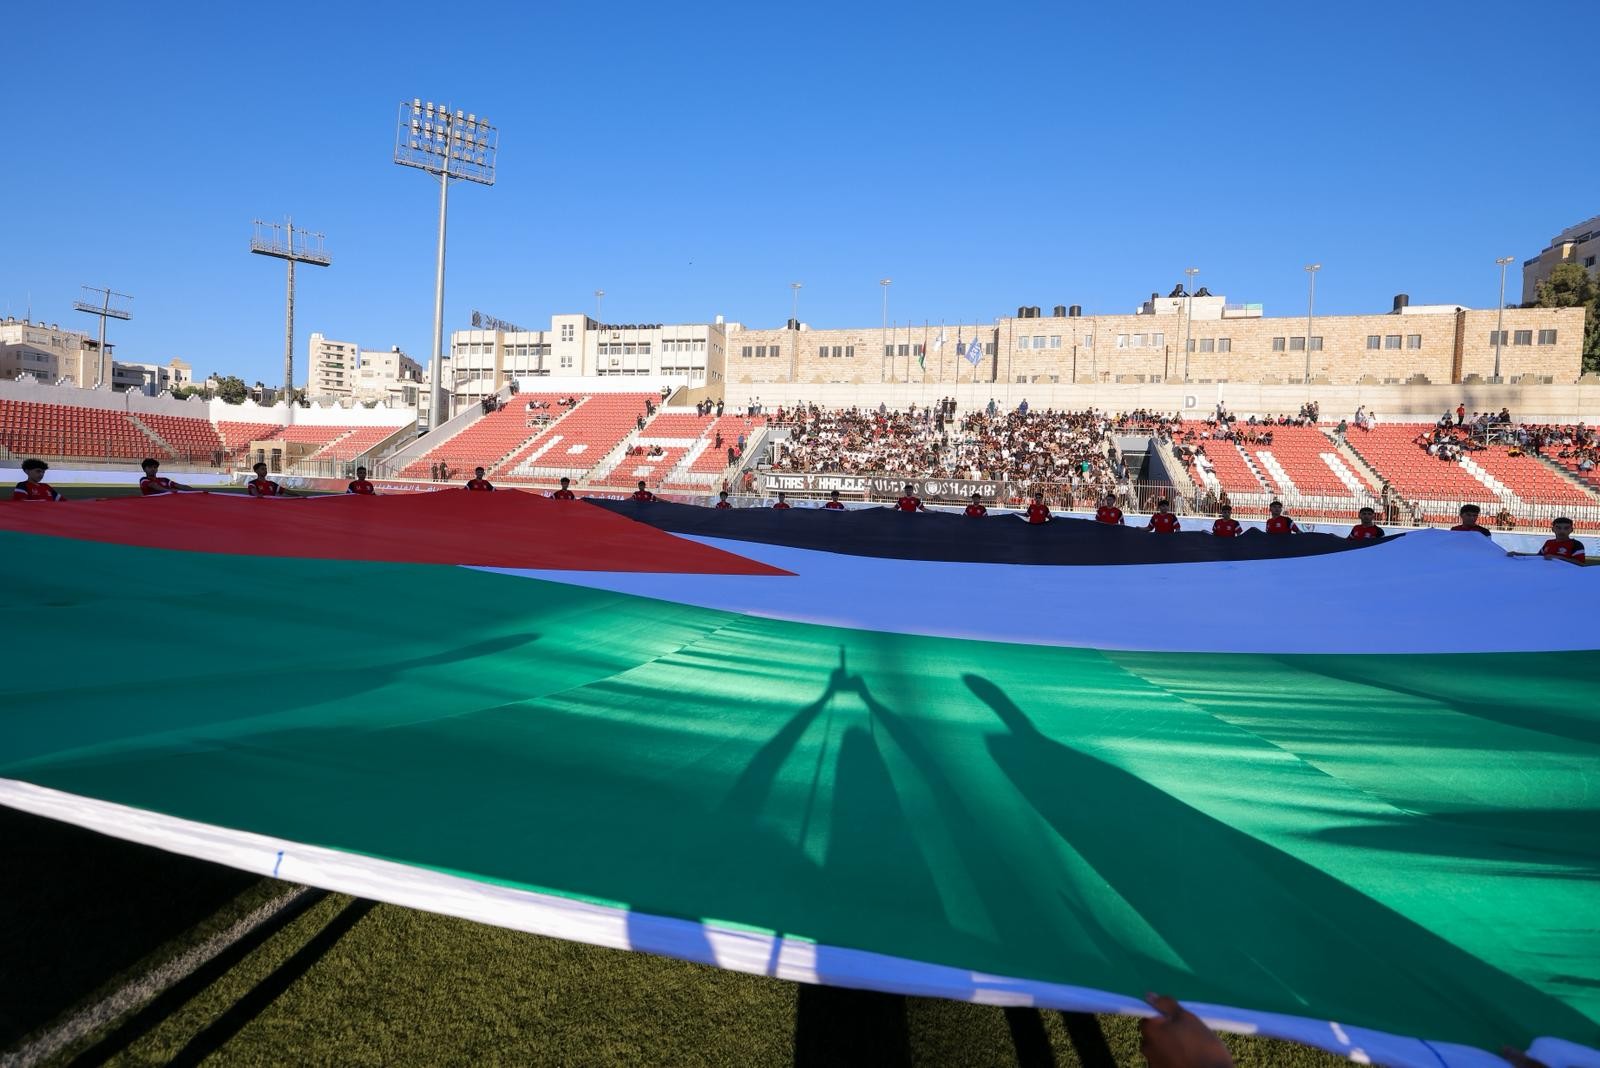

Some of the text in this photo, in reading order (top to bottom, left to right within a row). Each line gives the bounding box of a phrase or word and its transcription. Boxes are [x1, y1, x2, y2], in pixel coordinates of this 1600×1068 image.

[1185, 396, 1197, 409] D
[766, 476, 804, 488] ULTRAS
[874, 480, 919, 494] ULTRS
